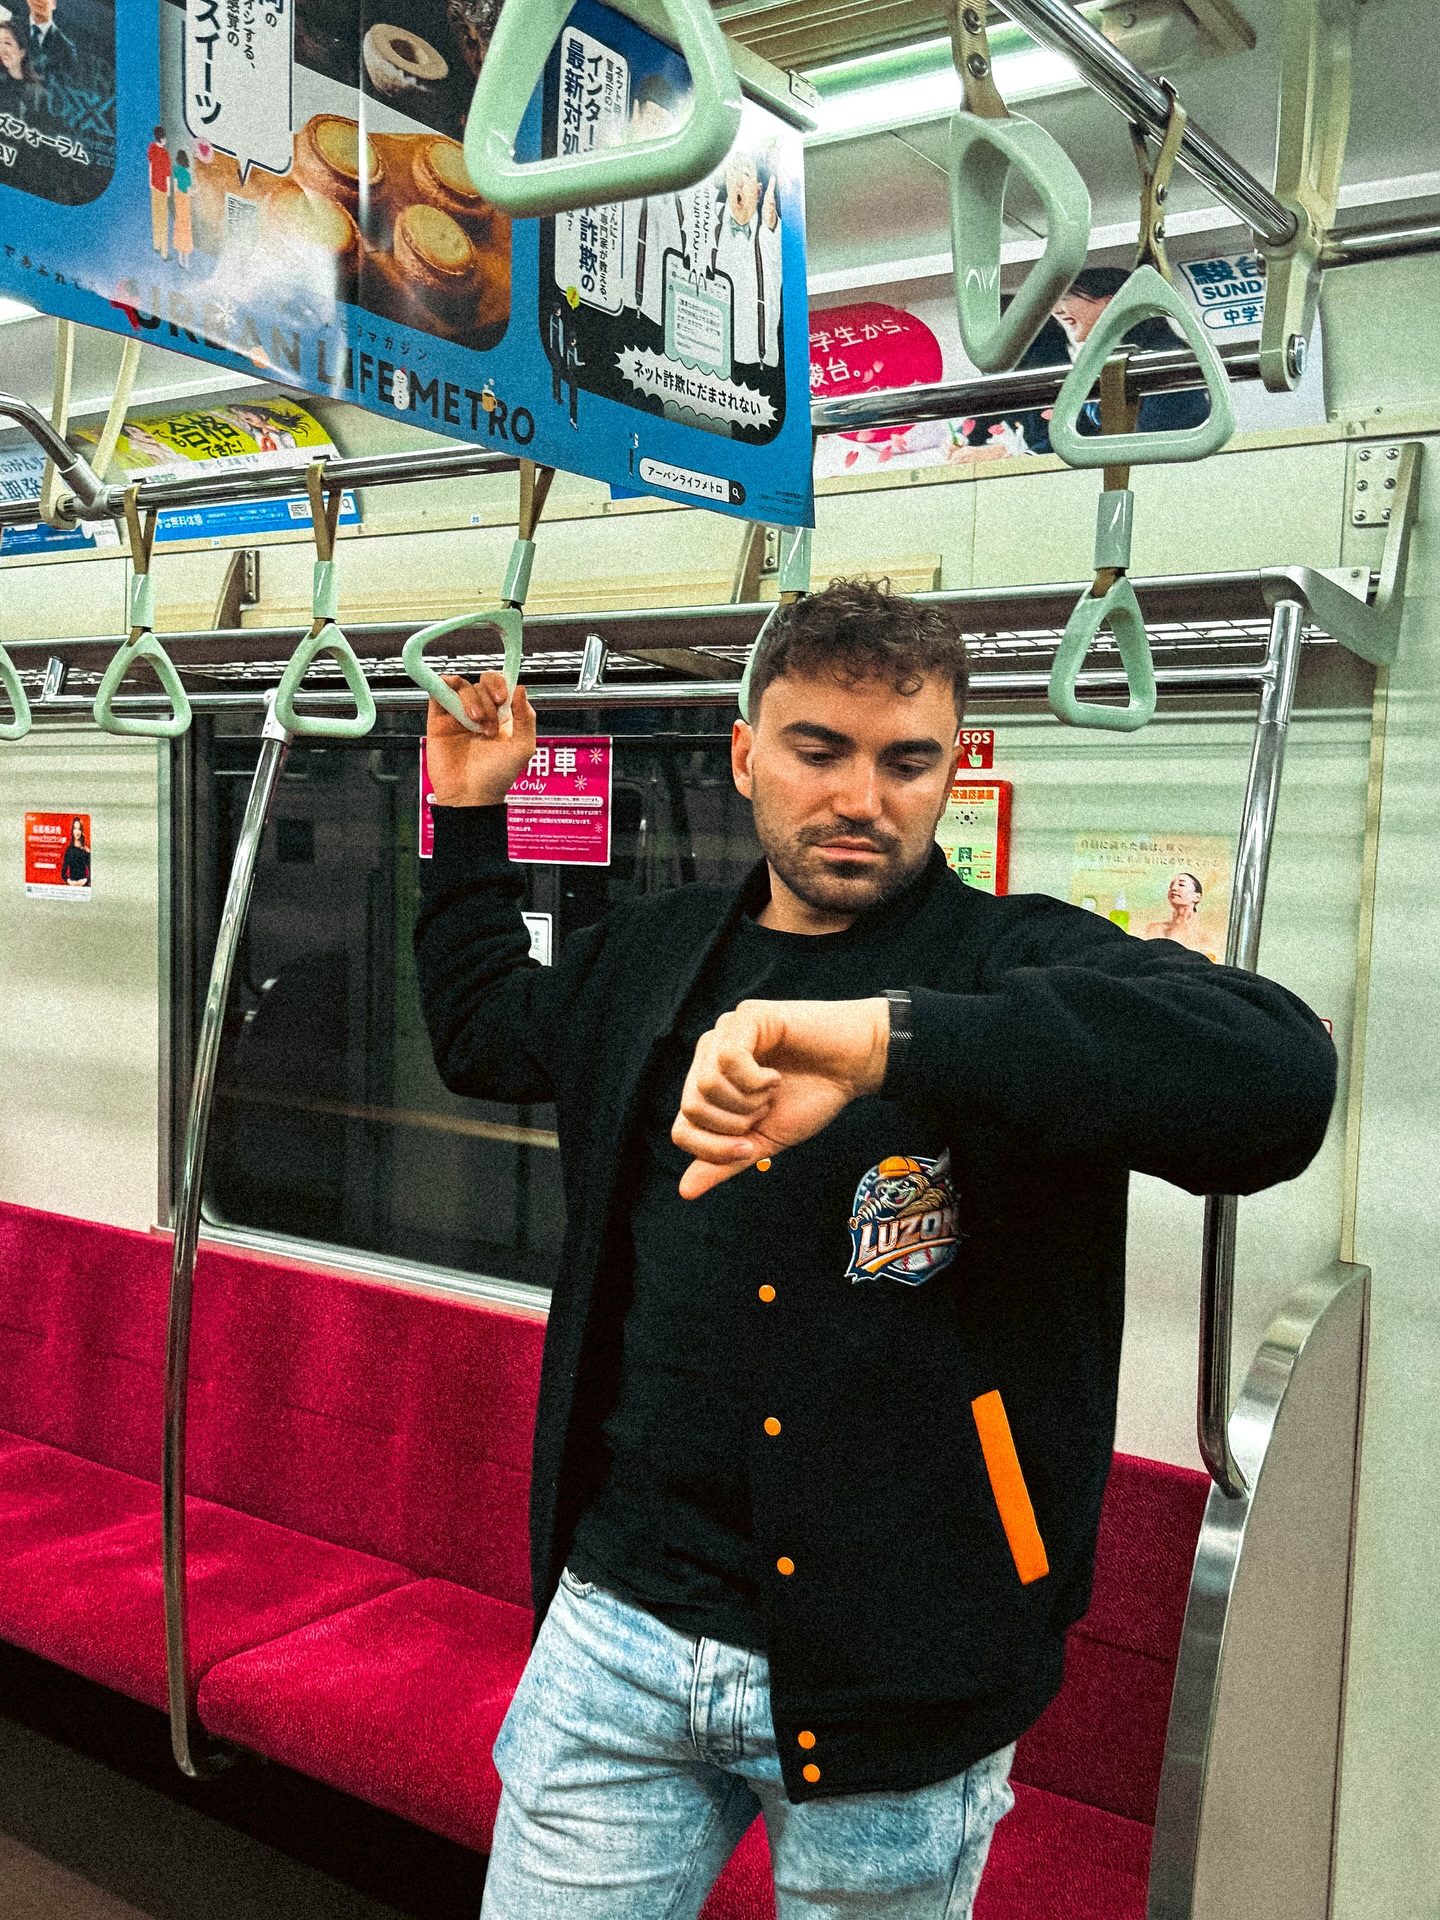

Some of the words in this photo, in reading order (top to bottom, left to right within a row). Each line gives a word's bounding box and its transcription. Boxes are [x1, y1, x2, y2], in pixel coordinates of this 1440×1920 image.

[194, 0, 222, 125] スイーツ
[584, 55, 603, 152] インター
[579, 207, 599, 292] 詐欺の
[1223, 304, 1264, 324] 中学
[134, 285, 301, 370] URBAN
[317, 340, 396, 405] LIFE
[409, 370, 536, 446] METRO
[633, 359, 761, 416] ネット詐欺にだまされない
[167, 414, 240, 449] 合格
[647, 466, 723, 494] アーバンライフメトロ
[962, 731, 991, 745] SOS
[526, 746, 578, 778] 用車
[519, 778, 547, 794] Only
